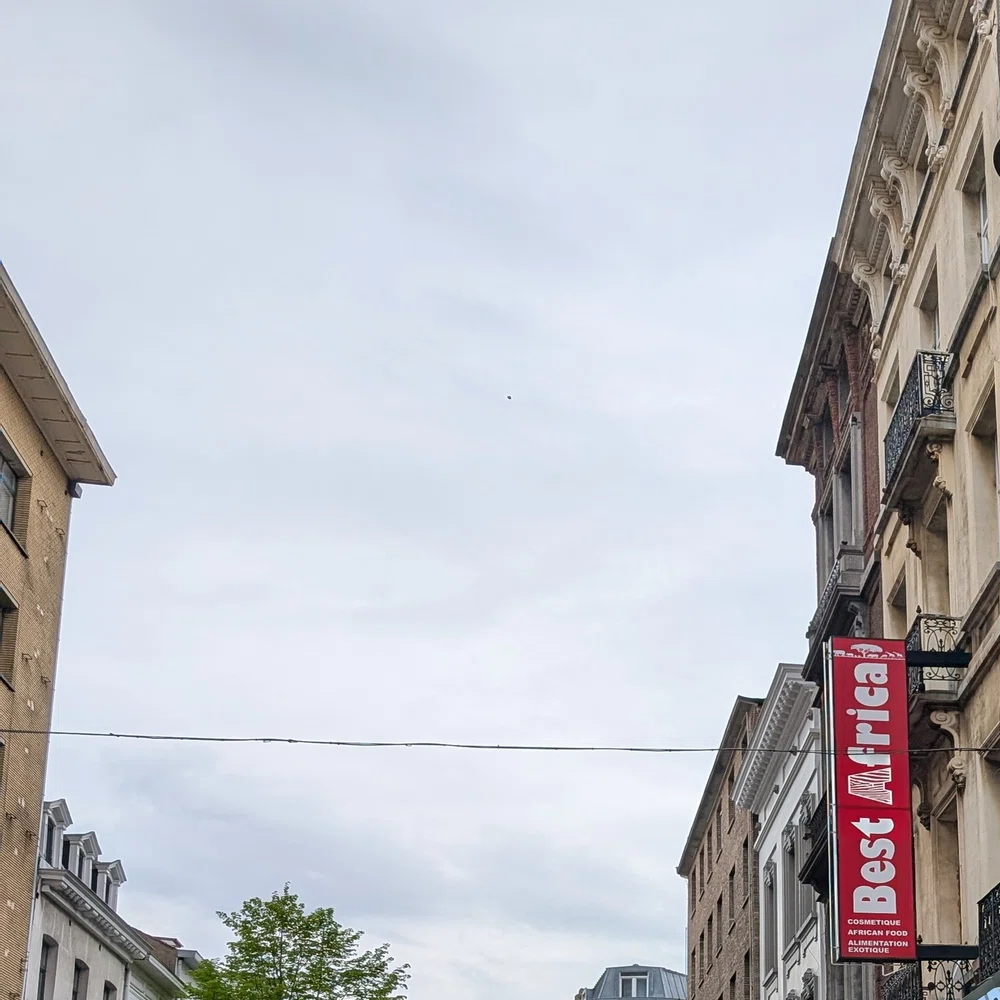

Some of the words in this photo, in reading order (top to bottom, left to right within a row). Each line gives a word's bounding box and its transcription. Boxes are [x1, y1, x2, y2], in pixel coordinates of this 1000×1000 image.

[845, 662, 893, 805] Africa
[850, 817, 897, 914] Best
[847, 918, 901, 926] COSMETIQUE
[848, 939, 909, 947] ALIMENTATION
[848, 946, 890, 954] EXOTIQUE
